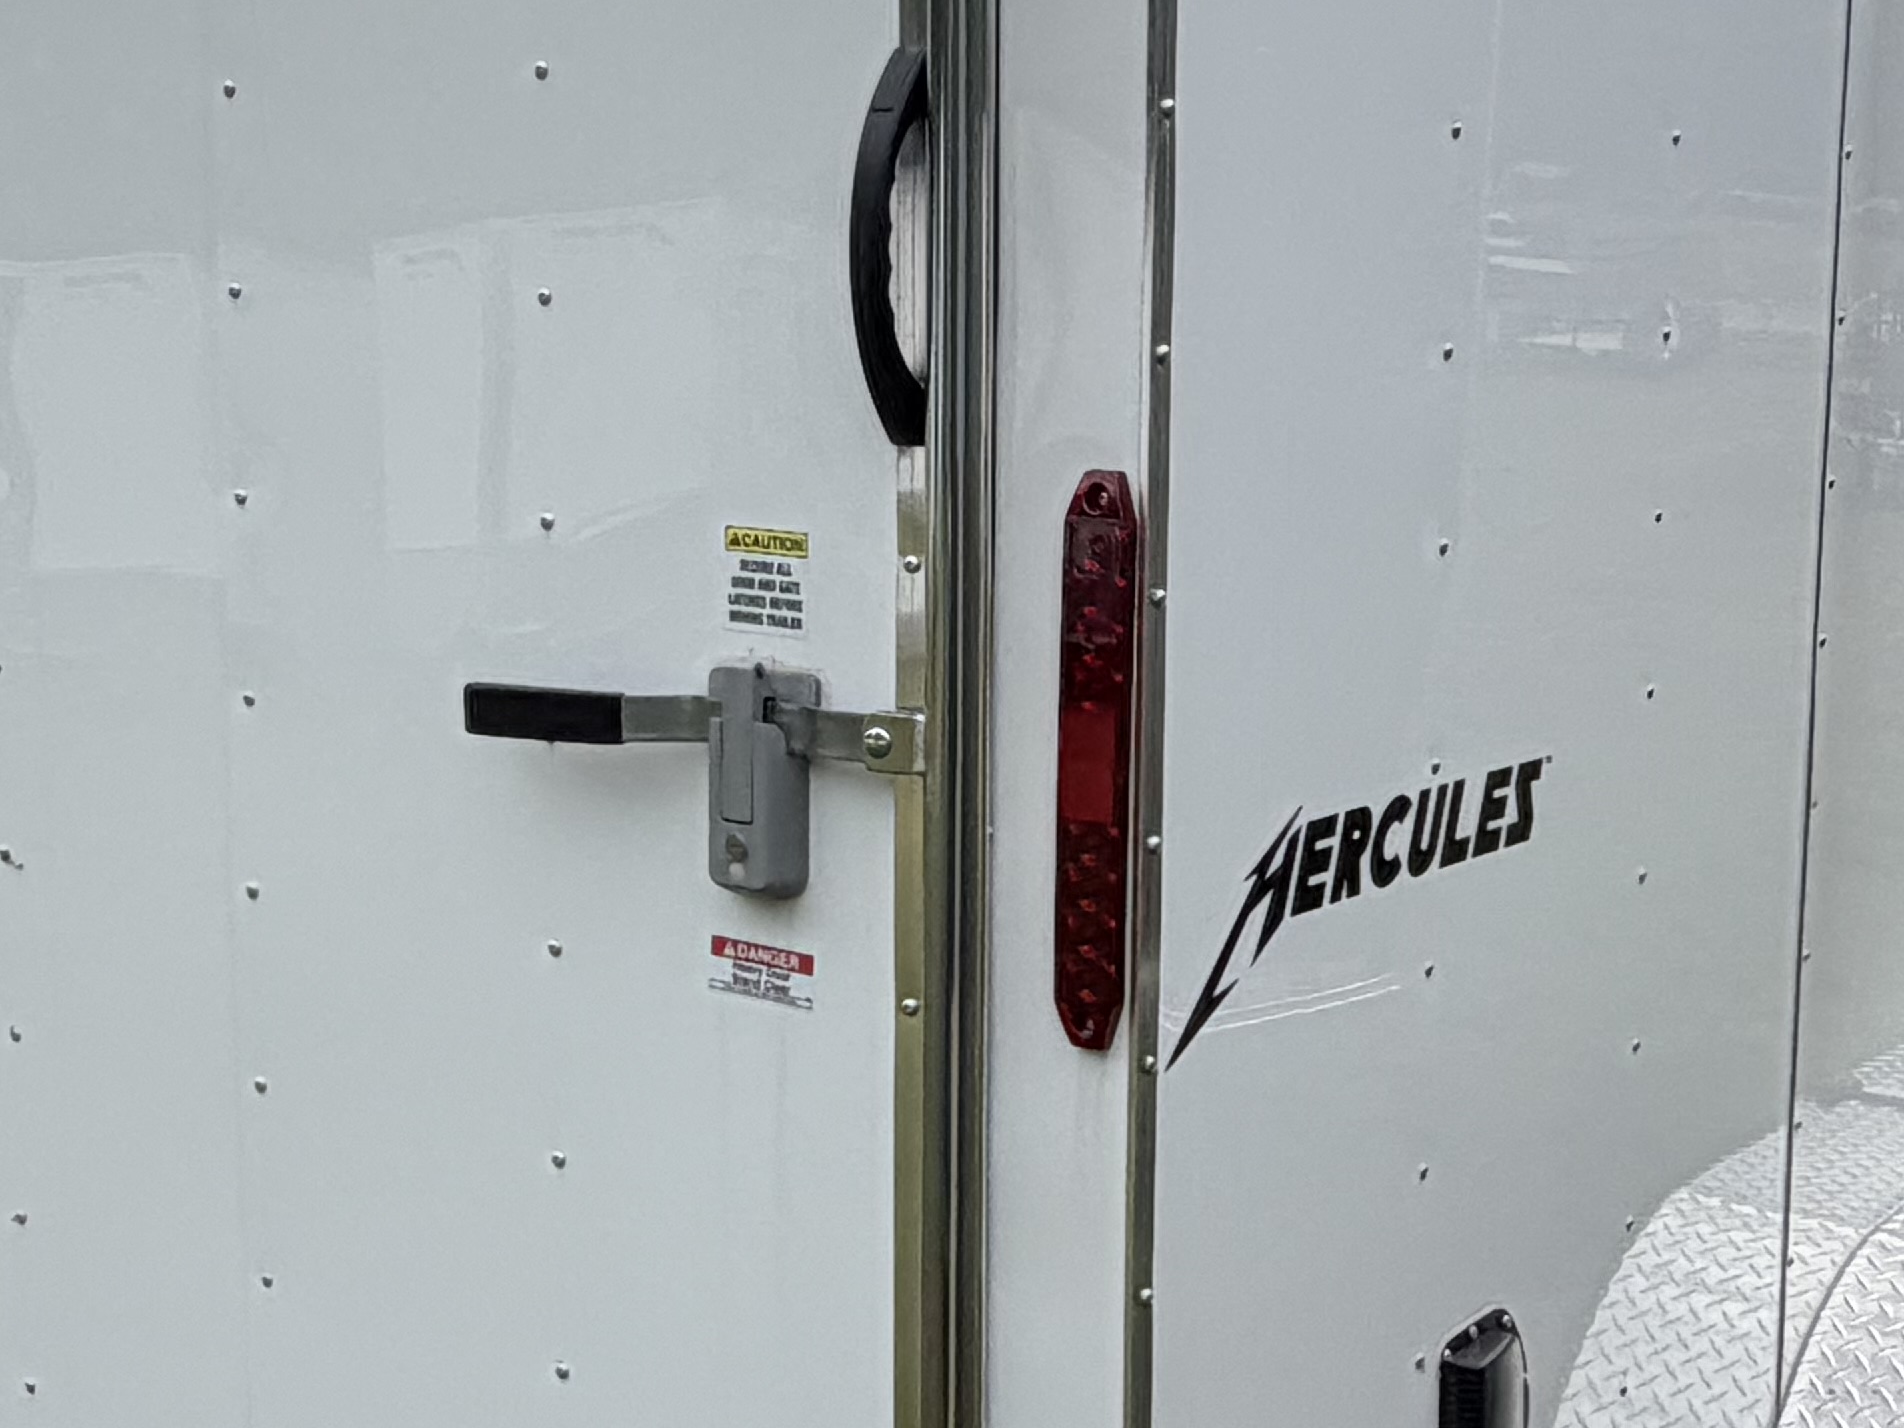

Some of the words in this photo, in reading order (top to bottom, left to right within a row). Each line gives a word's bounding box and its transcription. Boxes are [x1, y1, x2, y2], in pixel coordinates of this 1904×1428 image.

[741, 532, 805, 552] CAUTION
[1165, 757, 1546, 1073] HERCULES
[736, 942, 800, 971] DANGER
